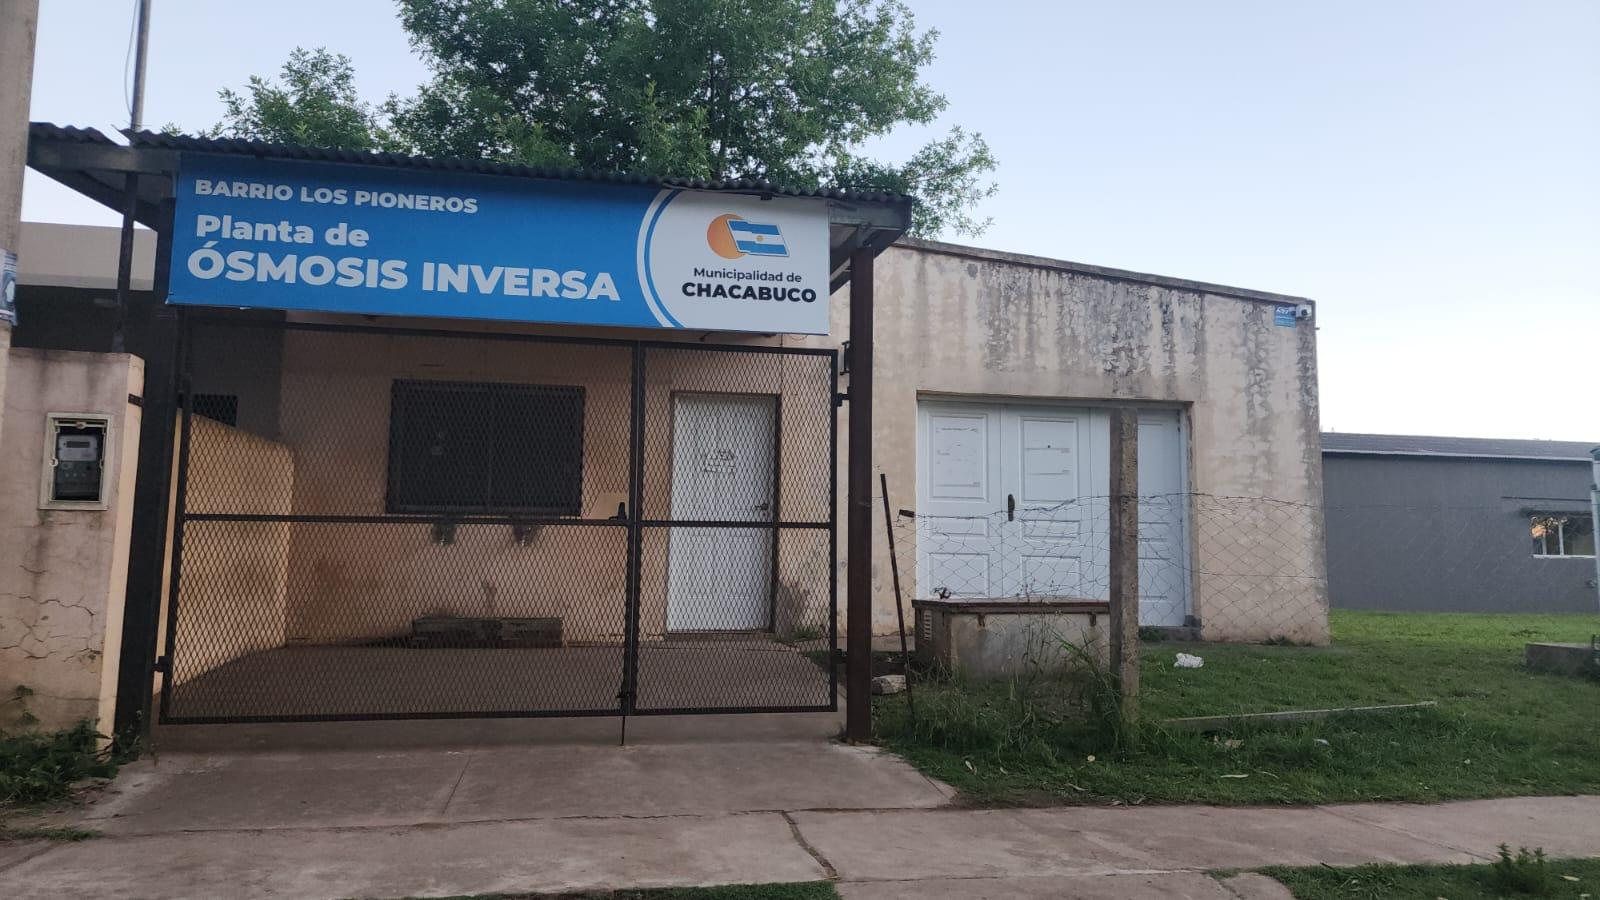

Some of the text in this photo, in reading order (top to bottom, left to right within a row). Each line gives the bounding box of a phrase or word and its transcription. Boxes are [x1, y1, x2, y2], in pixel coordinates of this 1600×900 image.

[195, 179, 479, 214] BARRIO LOS PIONEROS
[196, 214, 370, 247] Planta de
[187, 240, 621, 301] ÓSMOSIS INVERSA
[693, 267, 802, 282] Municipalidad de
[681, 282, 817, 302] CHACABUCO
